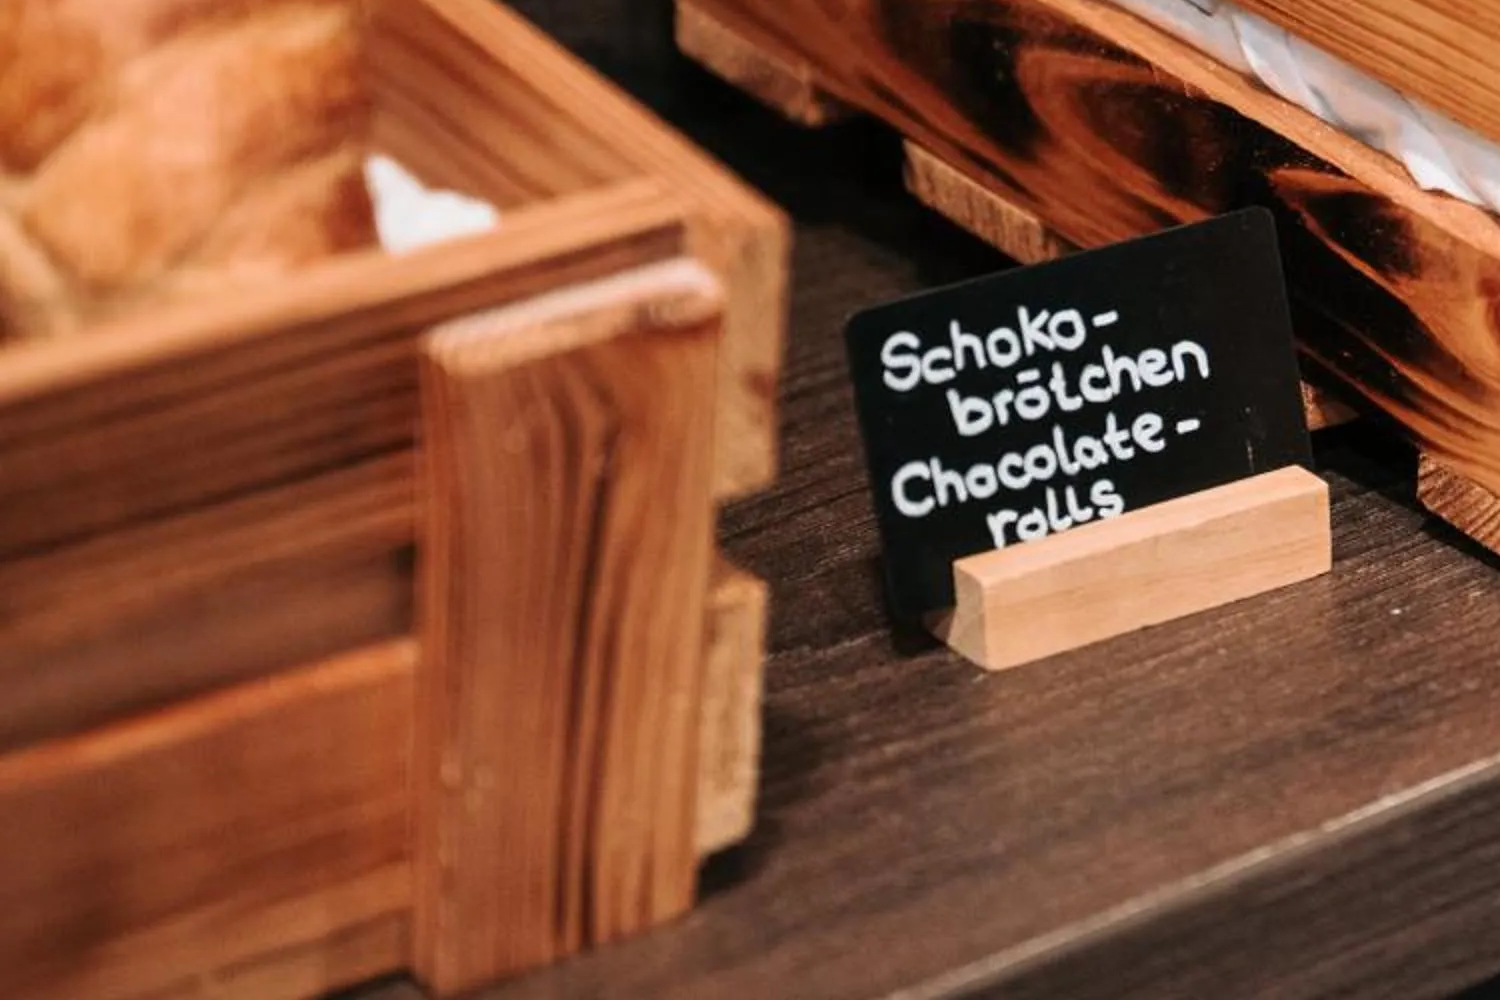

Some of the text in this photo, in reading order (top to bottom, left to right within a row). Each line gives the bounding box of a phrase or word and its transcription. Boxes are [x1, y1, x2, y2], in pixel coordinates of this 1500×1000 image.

[880, 306, 1119, 392] Schoko-
[891, 412, 1201, 517] Chocolate-
[986, 479, 1125, 549] rolls
